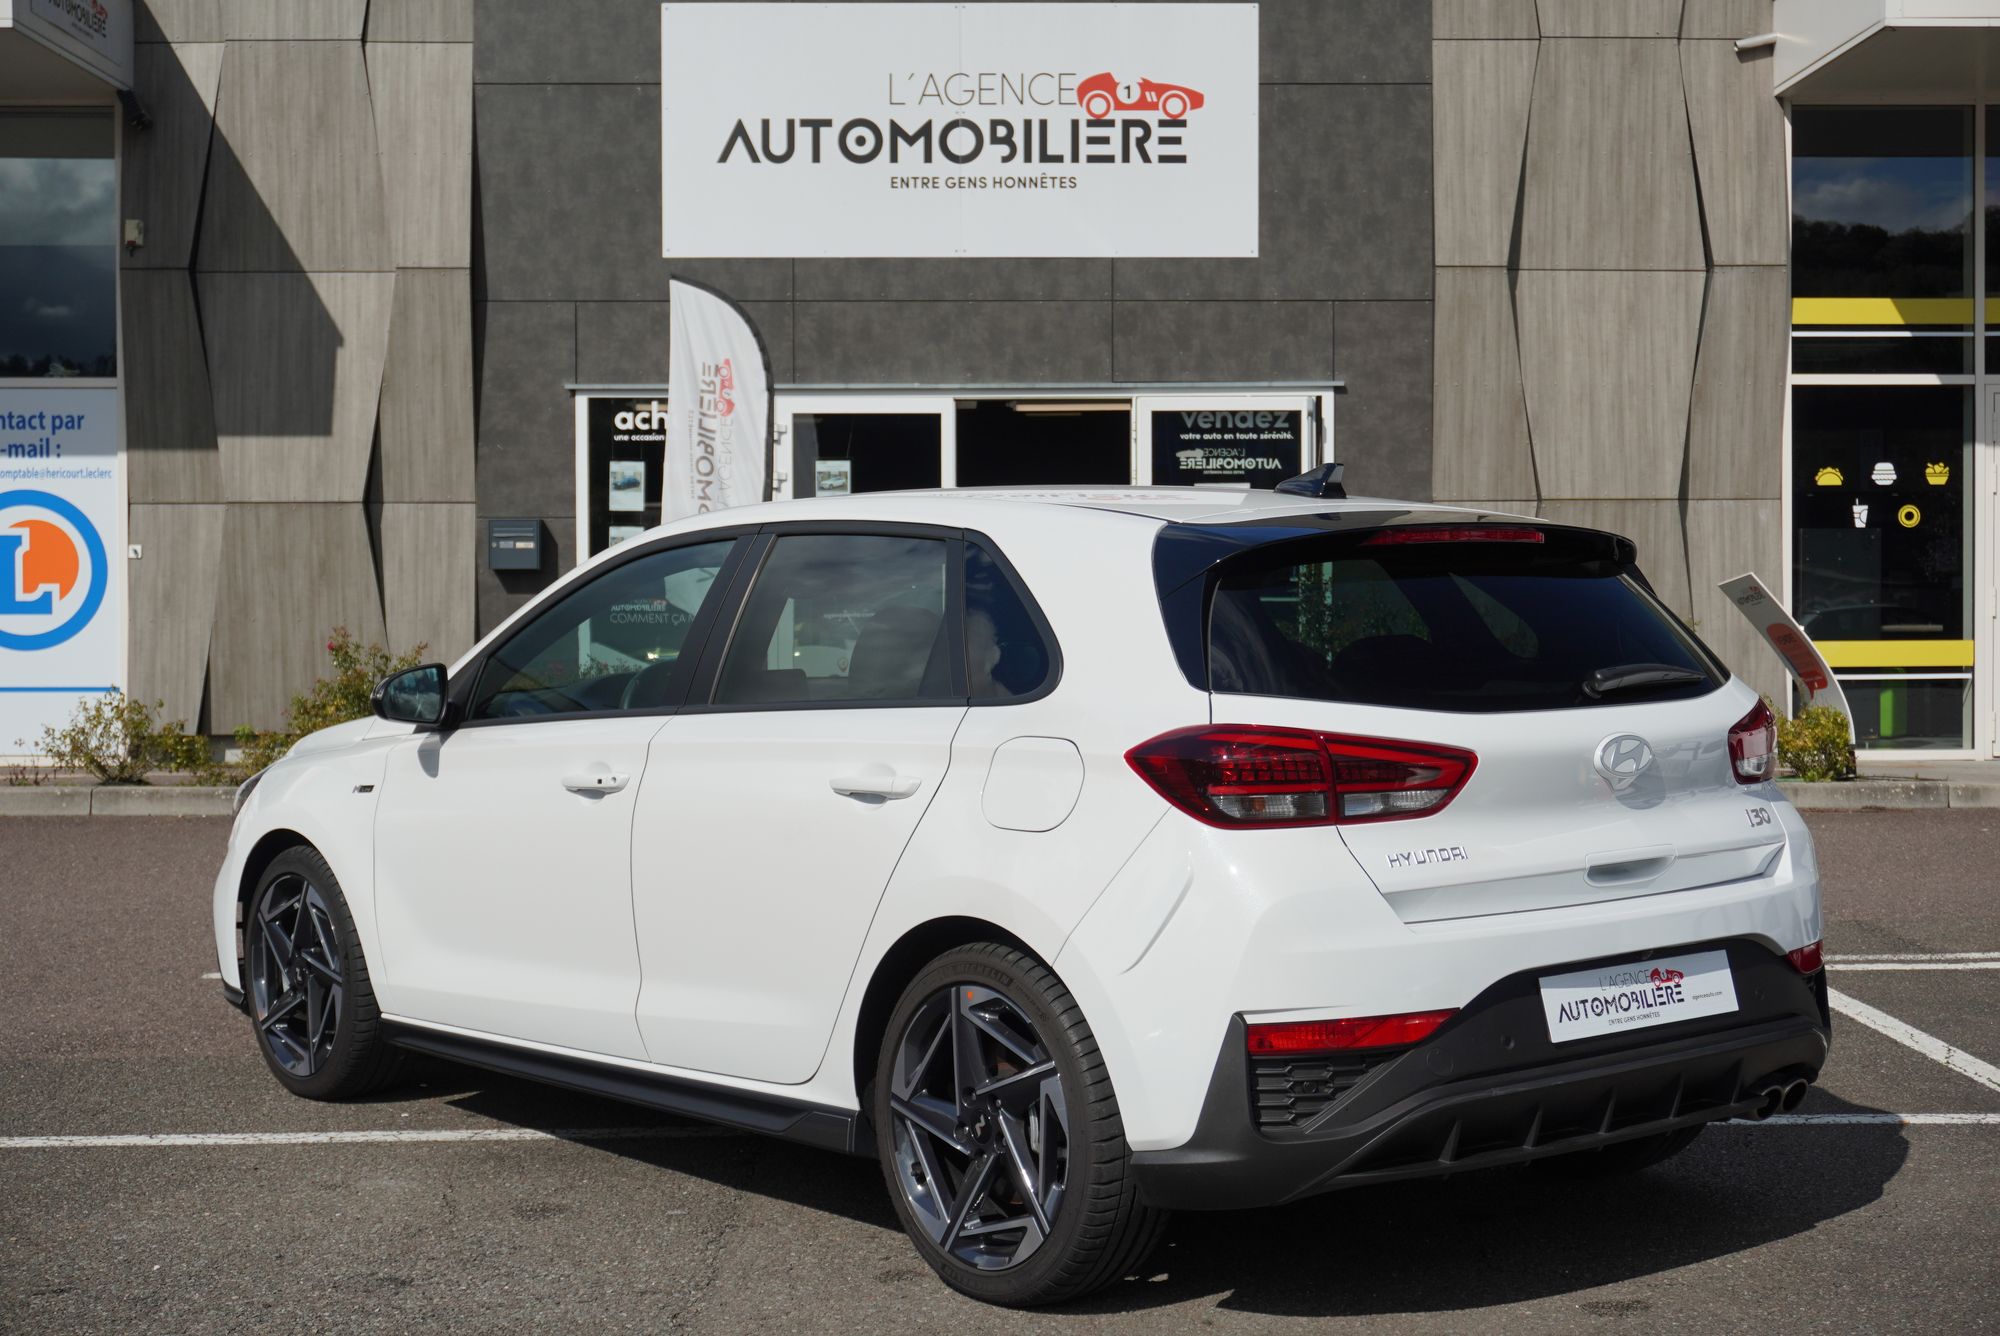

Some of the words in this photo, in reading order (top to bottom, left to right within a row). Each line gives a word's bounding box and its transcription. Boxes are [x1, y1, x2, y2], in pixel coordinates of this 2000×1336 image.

[889, 73, 1077, 105] L'AGENCE
[1123, 84, 1131, 99] 1
[890, 176, 940, 190] ENTRE
[945, 176, 988, 190] GENS
[993, 172, 1078, 190] HONNÊTES
[51, 414, 85, 436] par
[614, 400, 668, 430] ach
[1181, 410, 1290, 429] vendez
[1180, 432, 1201, 440] votre
[1203, 432, 1222, 440] auto
[1236, 432, 1258, 440] toute
[1386, 846, 1469, 869] HYUNDAI
